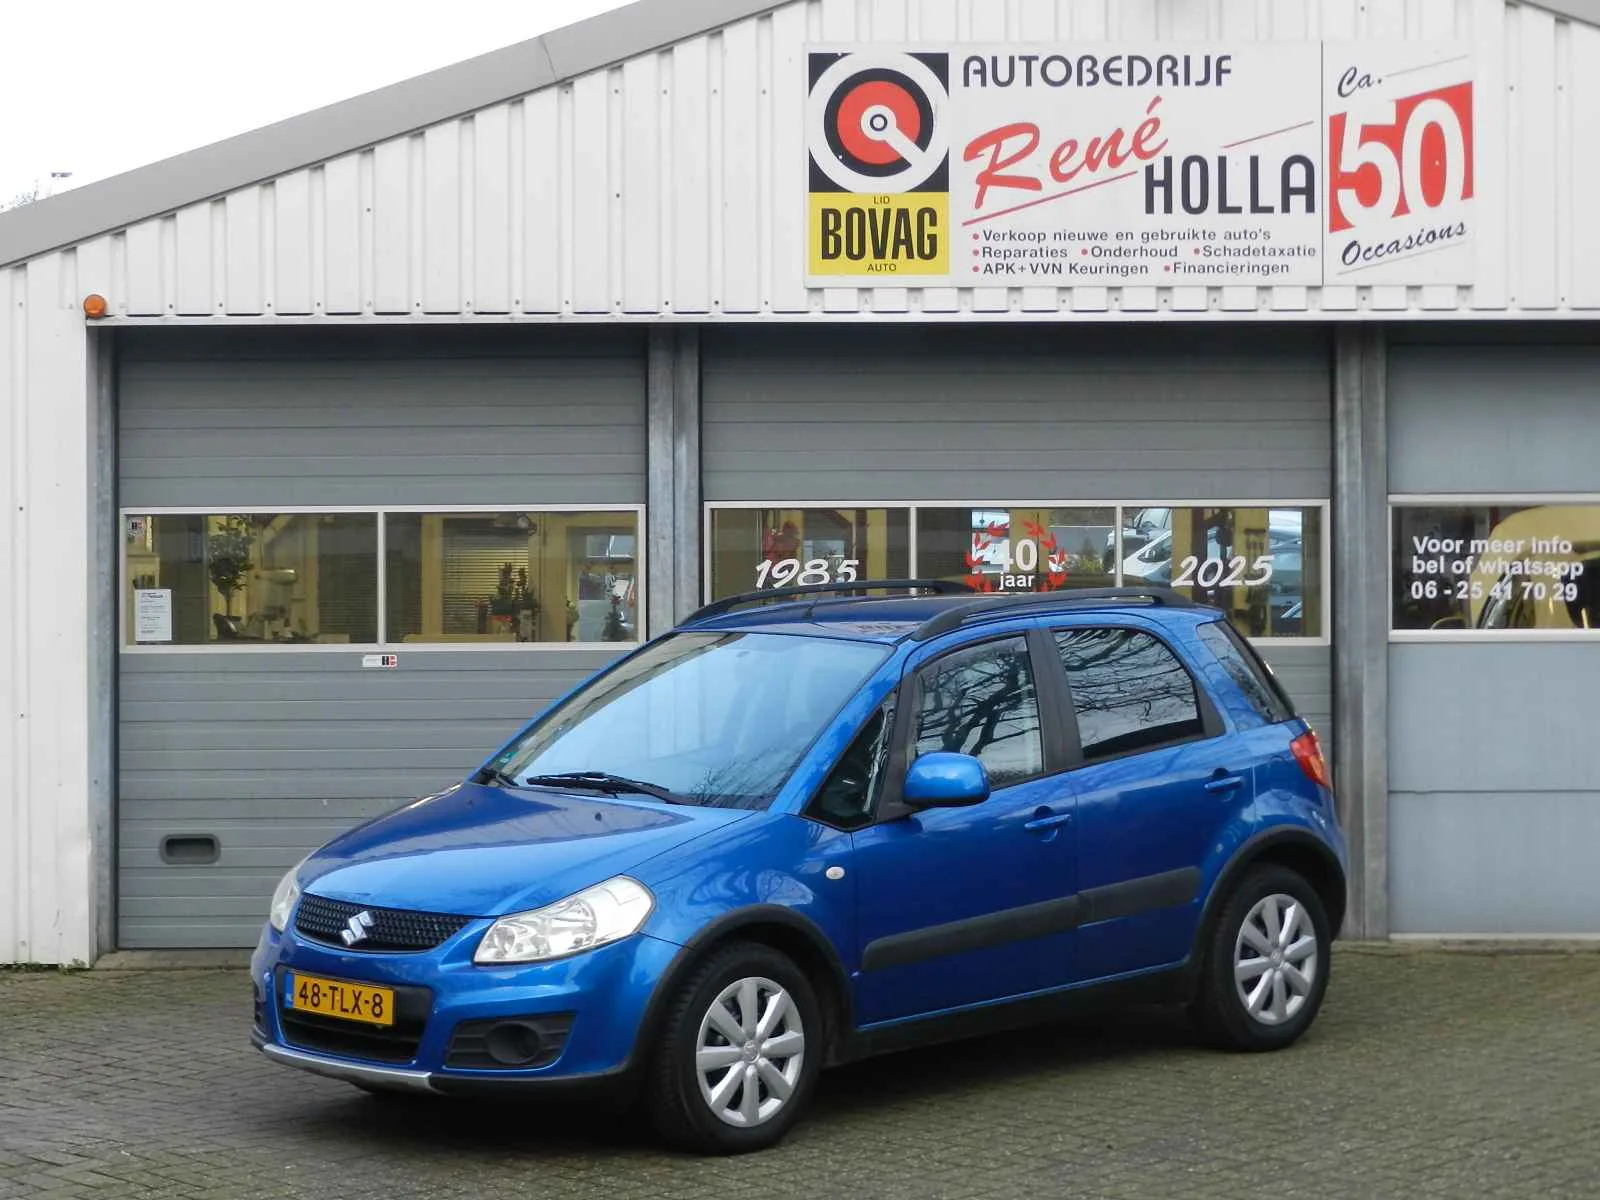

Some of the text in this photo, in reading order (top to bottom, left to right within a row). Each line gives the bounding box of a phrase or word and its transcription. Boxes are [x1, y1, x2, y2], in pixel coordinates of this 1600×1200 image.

[963, 54, 1232, 88] AUTOBEDRIJF
[1337, 66, 1382, 98] Ca.
[963, 95, 1316, 215] René HOLLA
[1337, 98, 1465, 225] 50
[873, 195, 891, 205] LID
[821, 206, 938, 261] BOVAG
[982, 228, 1272, 244] Verkoop nieuwe en gebruikte auto's
[1341, 221, 1467, 266] Occasions
[982, 244, 1317, 261] Reparaties Onderhoud Schadetaxatie
[866, 263, 897, 272] AUTO
[1069, 262, 1149, 278] Keuringen
[1173, 261, 1290, 277] Financieringen
[1412, 535, 1573, 554] Voor meer info
[755, 558, 860, 589] 1985
[999, 571, 1036, 591] jaar
[1169, 554, 1276, 588] 2025
[1412, 555, 1584, 581] bel of whatsapp
[1410, 580, 1438, 600] 06
[1456, 580, 1484, 600] 25
[1489, 580, 1513, 600] 41
[1521, 581, 1546, 601] 70
[1552, 582, 1578, 601] 29
[299, 980, 384, 1018] 48-TLX-8
